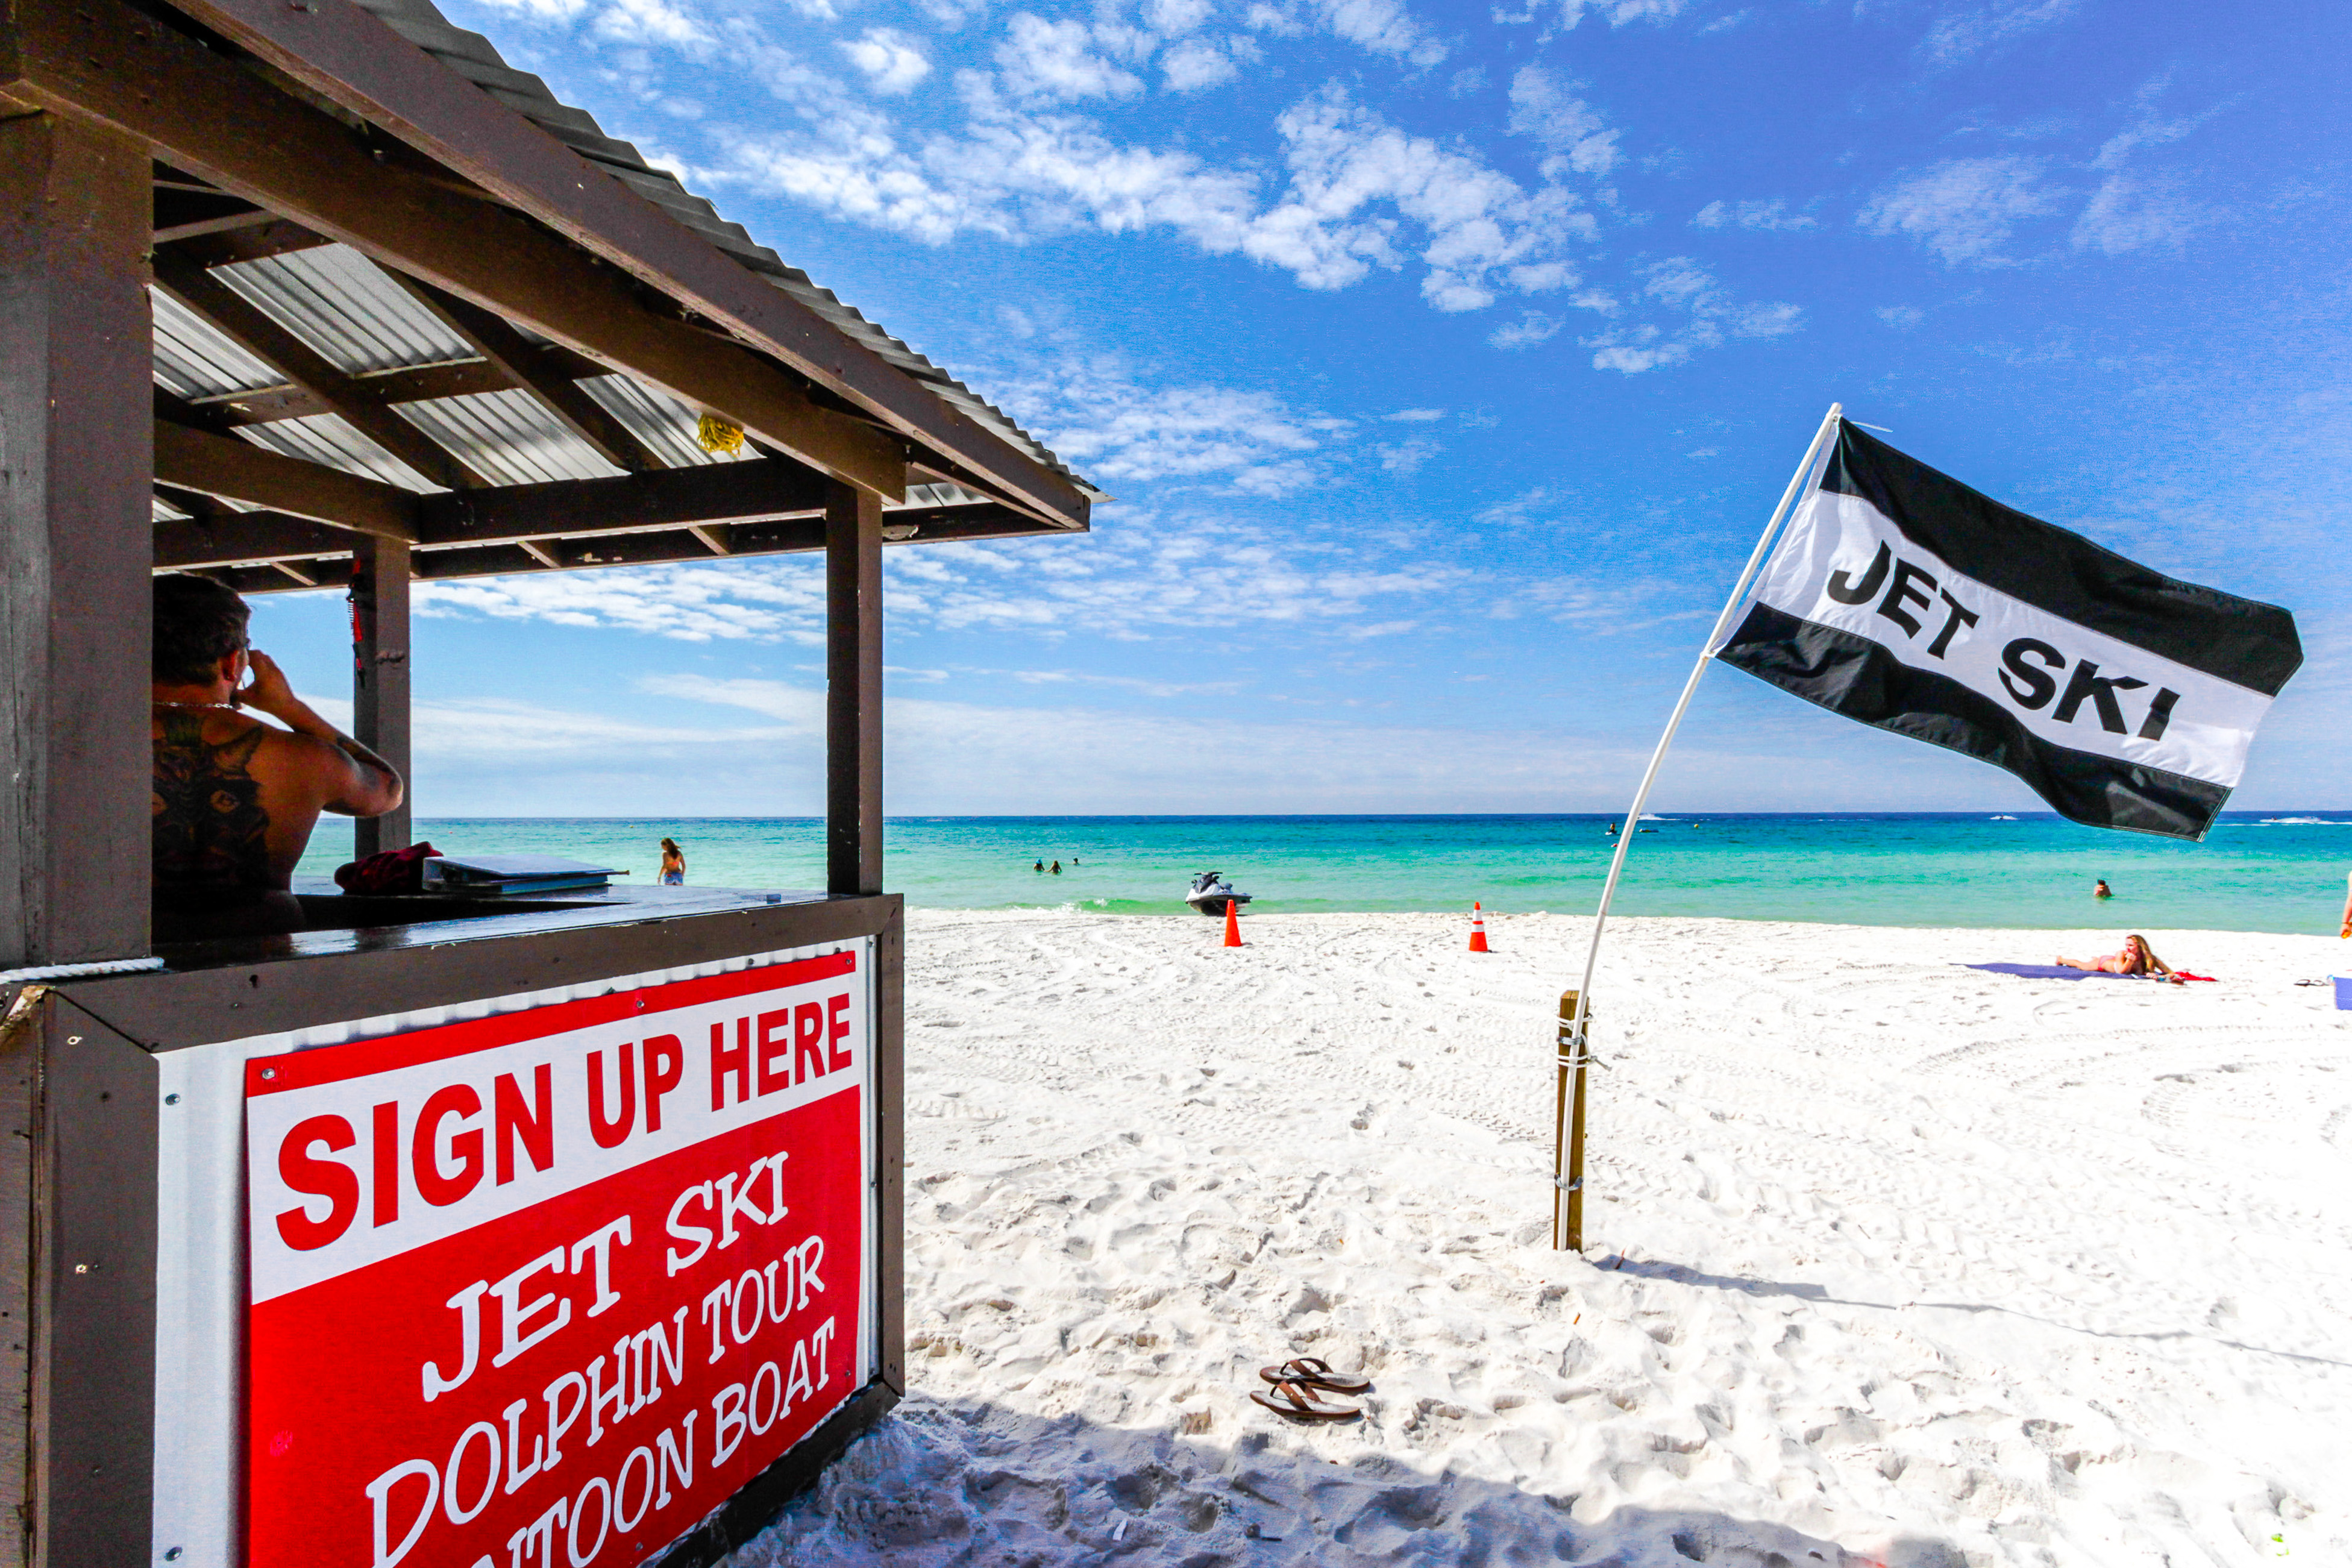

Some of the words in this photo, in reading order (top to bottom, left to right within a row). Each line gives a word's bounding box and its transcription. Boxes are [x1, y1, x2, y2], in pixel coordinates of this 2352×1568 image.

[1827, 539, 1980, 660] JET
[1998, 637, 2181, 742] SKI
[275, 1062, 554, 1252] SIGN
[586, 1033, 684, 1150] UP
[709, 992, 853, 1112] HERE
[365, 1305, 689, 1568] DOLPHIN
[701, 1234, 826, 1366] TOUR
[421, 1214, 632, 1403] JET
[665, 1150, 789, 1278] SKI
[711, 1315, 835, 1469] BOAT
